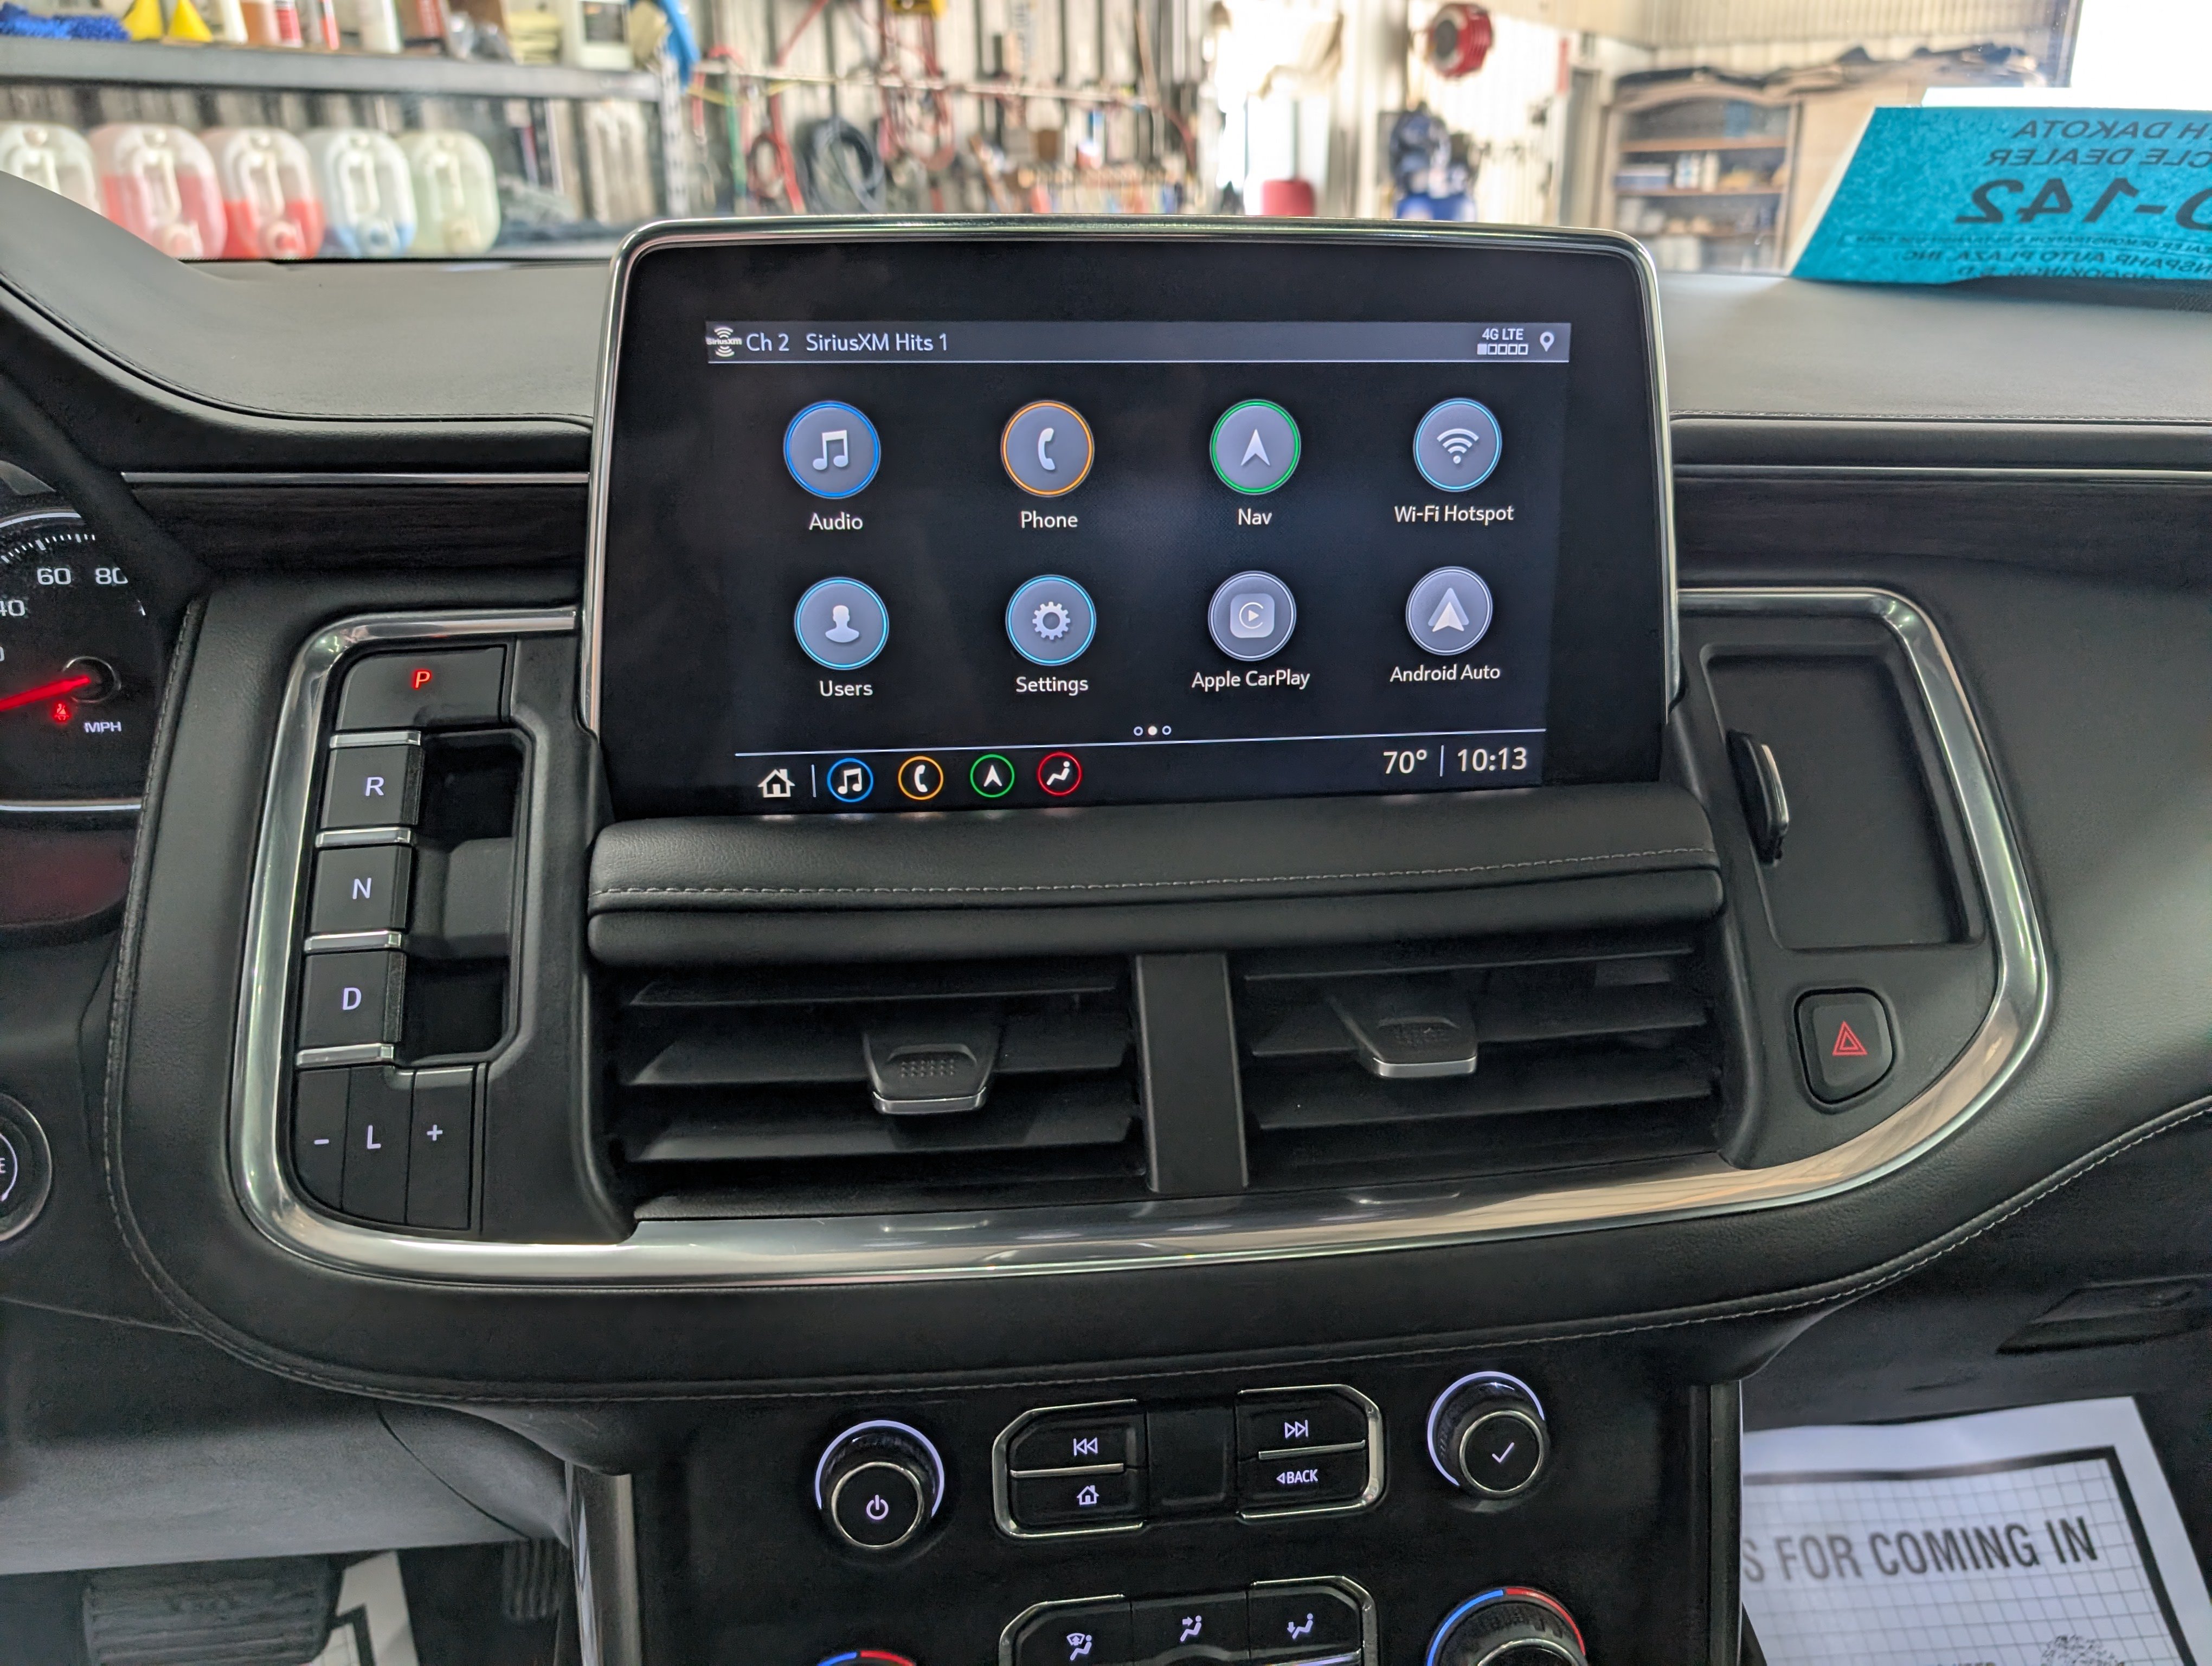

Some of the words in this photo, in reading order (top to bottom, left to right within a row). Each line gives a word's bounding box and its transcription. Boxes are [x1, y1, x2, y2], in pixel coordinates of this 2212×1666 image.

[746, 332, 773, 351] Ch
[777, 333, 790, 351] 2
[806, 333, 890, 351] SiriusXM
[896, 333, 934, 351] Hits
[939, 333, 947, 351] 1
[1482, 328, 1499, 341] 4G
[1502, 328, 1524, 341] LTE
[808, 512, 864, 531] Audio
[1020, 510, 1079, 529] Phone
[1237, 508, 1272, 526] Nav
[1394, 505, 1439, 523] Wi-Fi
[1444, 504, 1514, 526] Hotspot
[37, 568, 72, 585] 60
[95, 567, 128, 585] 80
[414, 670, 431, 689] P
[1191, 671, 1242, 692] Apple
[1245, 670, 1311, 690] CarPlay
[1390, 664, 1457, 682] Android
[1459, 664, 1501, 681] Auto
[819, 681, 873, 697] Users
[1015, 676, 1089, 696] Settings
[83, 721, 122, 733] MPH
[1457, 747, 1527, 772] 10:13
[364, 776, 384, 796] R
[351, 877, 372, 900] N
[342, 987, 362, 1011] D
[366, 1124, 382, 1149] L
[1287, 1469, 1319, 1484] BACK
[1773, 1533, 1863, 1582] FOR
[1868, 1521, 2041, 1577] COMING
[2044, 1515, 2099, 1564] IN
